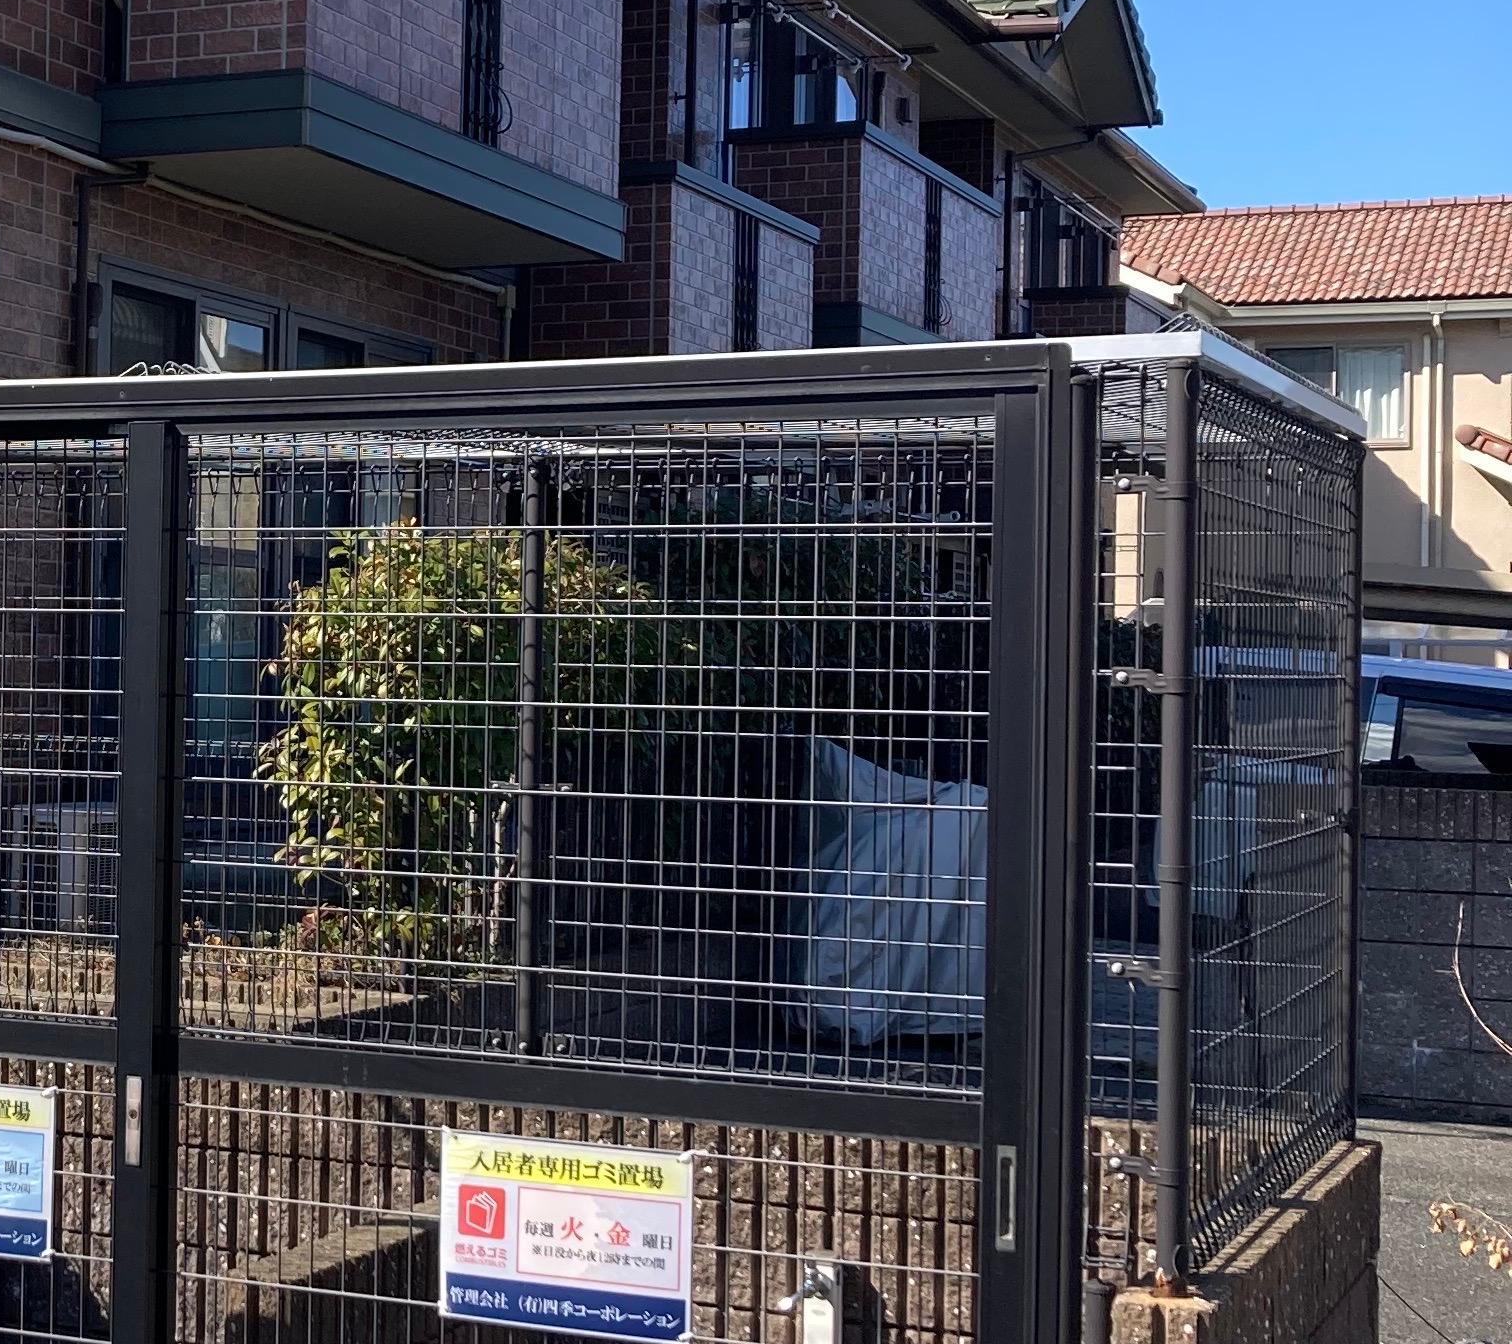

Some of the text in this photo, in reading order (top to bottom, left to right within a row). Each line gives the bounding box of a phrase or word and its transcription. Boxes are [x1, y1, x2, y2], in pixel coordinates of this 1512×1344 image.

[4, 1160, 30, 1176] 曜日
[470, 1150, 664, 1190] 入居者専用ゴミ置場
[524, 1219, 555, 1239] 毎週
[642, 1232, 673, 1251] 曜日
[449, 1285, 682, 1330] 管理会社 (有)四季コーポレーション
